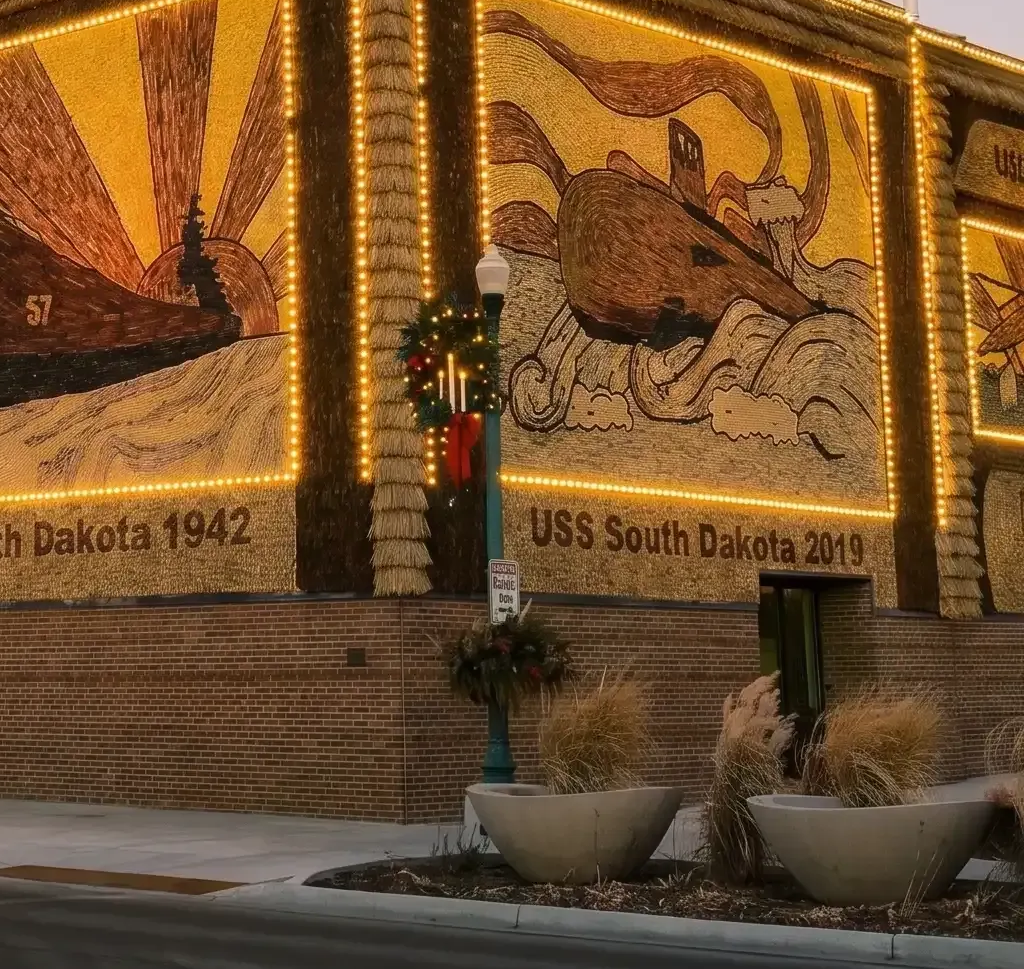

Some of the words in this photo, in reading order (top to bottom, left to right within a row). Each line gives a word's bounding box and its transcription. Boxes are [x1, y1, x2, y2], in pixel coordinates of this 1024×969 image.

[26, 295, 53, 326] 57
[34, 516, 152, 557] Dakota
[163, 506, 252, 550] 1942
[530, 507, 594, 550] USS
[605, 515, 690, 557] South
[699, 523, 796, 564] Dakota
[805, 531, 864, 567] 2019
